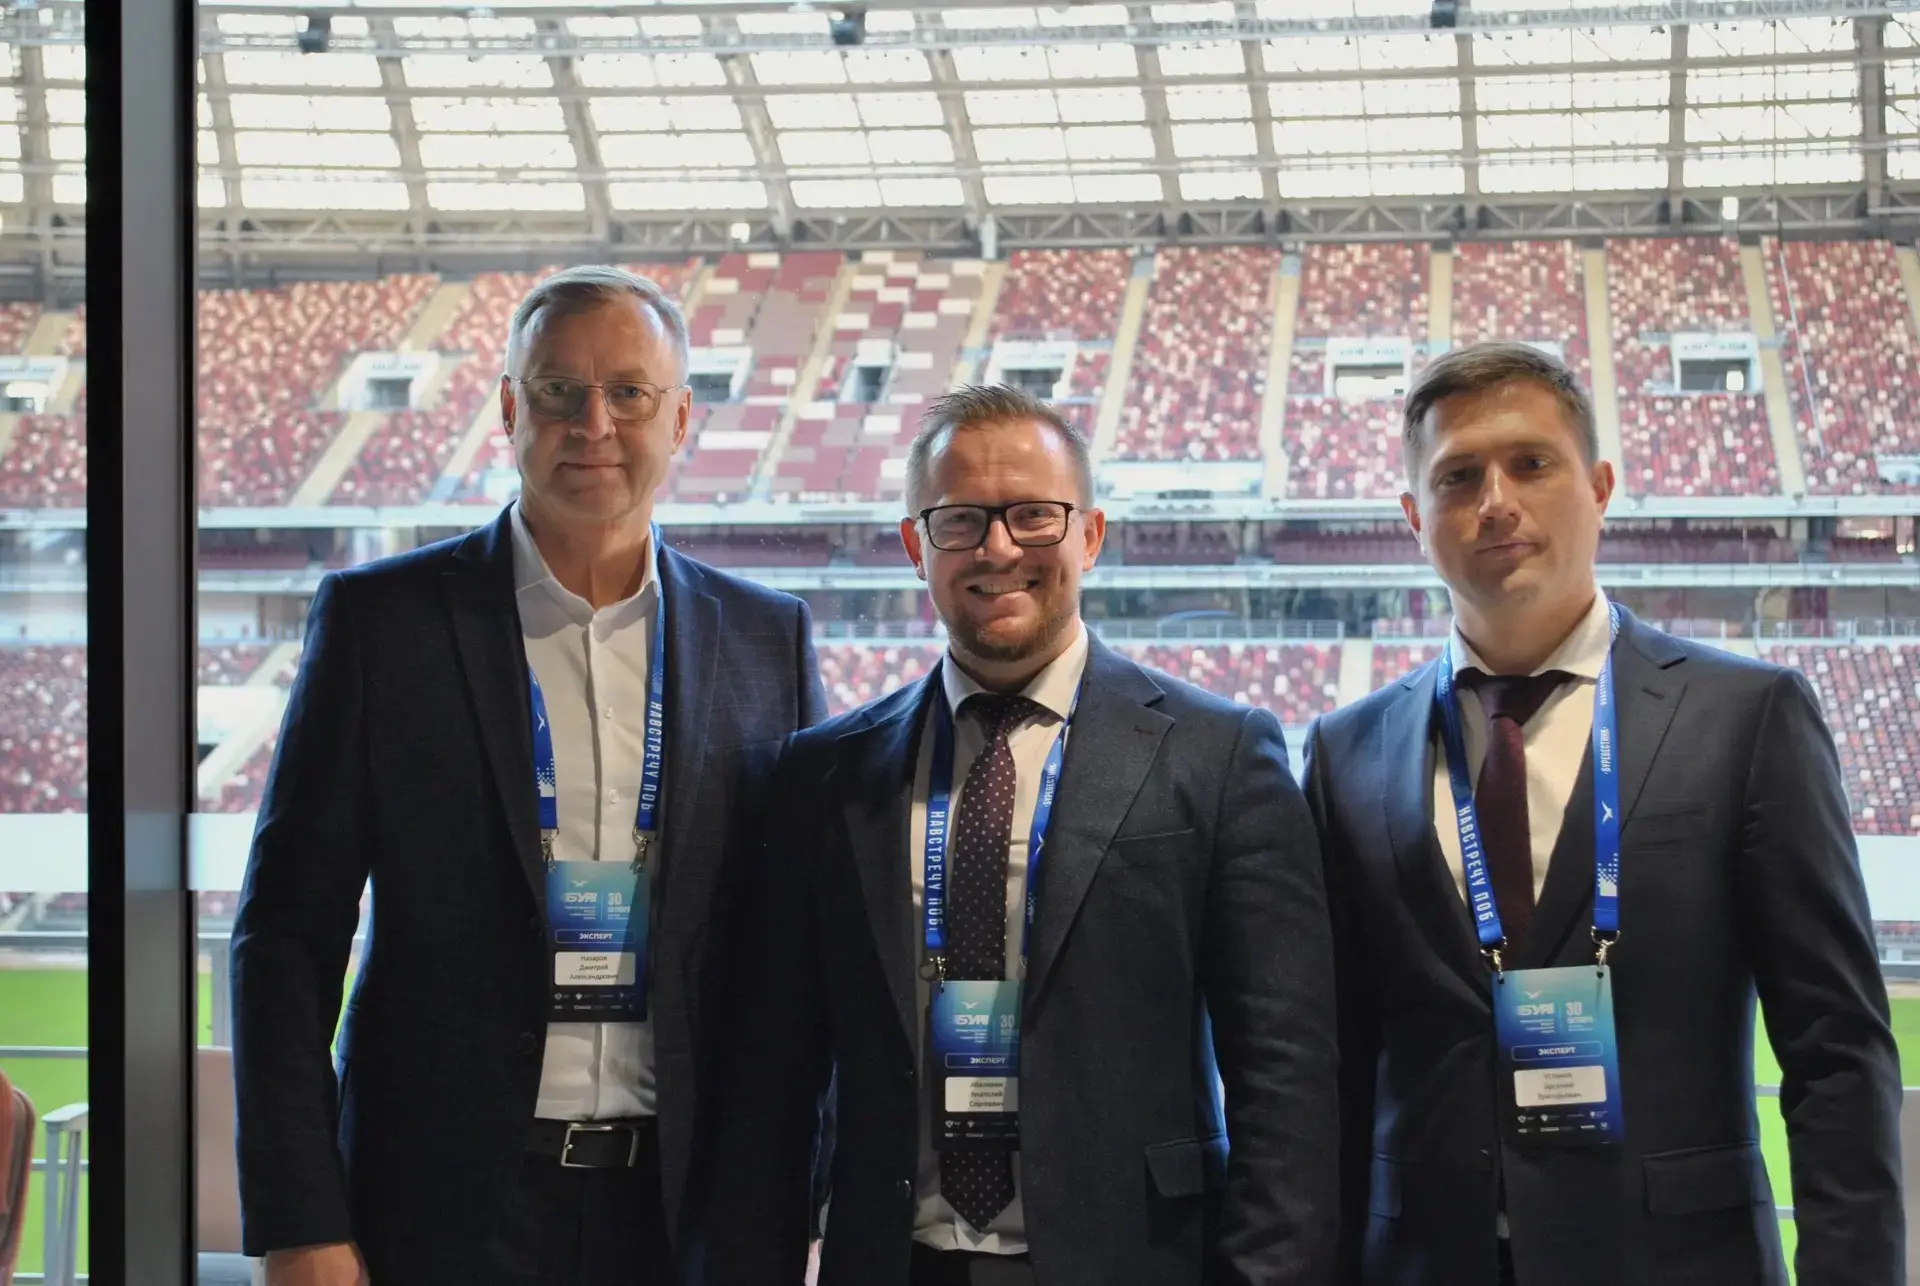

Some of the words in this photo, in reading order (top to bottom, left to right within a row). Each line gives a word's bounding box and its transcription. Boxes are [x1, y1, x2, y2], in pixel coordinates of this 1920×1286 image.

[644, 700, 663, 778] НАВСТРЕЧУ
[927, 810, 945, 890] НАВСТРЕЧУ
[1458, 805, 1486, 886] НАВСТРЕЧУ
[1474, 891, 1494, 921] ПОБ
[608, 892, 622, 905] 30
[1566, 1001, 1582, 1016] 30
[1001, 1014, 1015, 1028] 30
[1538, 1046, 1576, 1055] ЭКСПЕРТ
